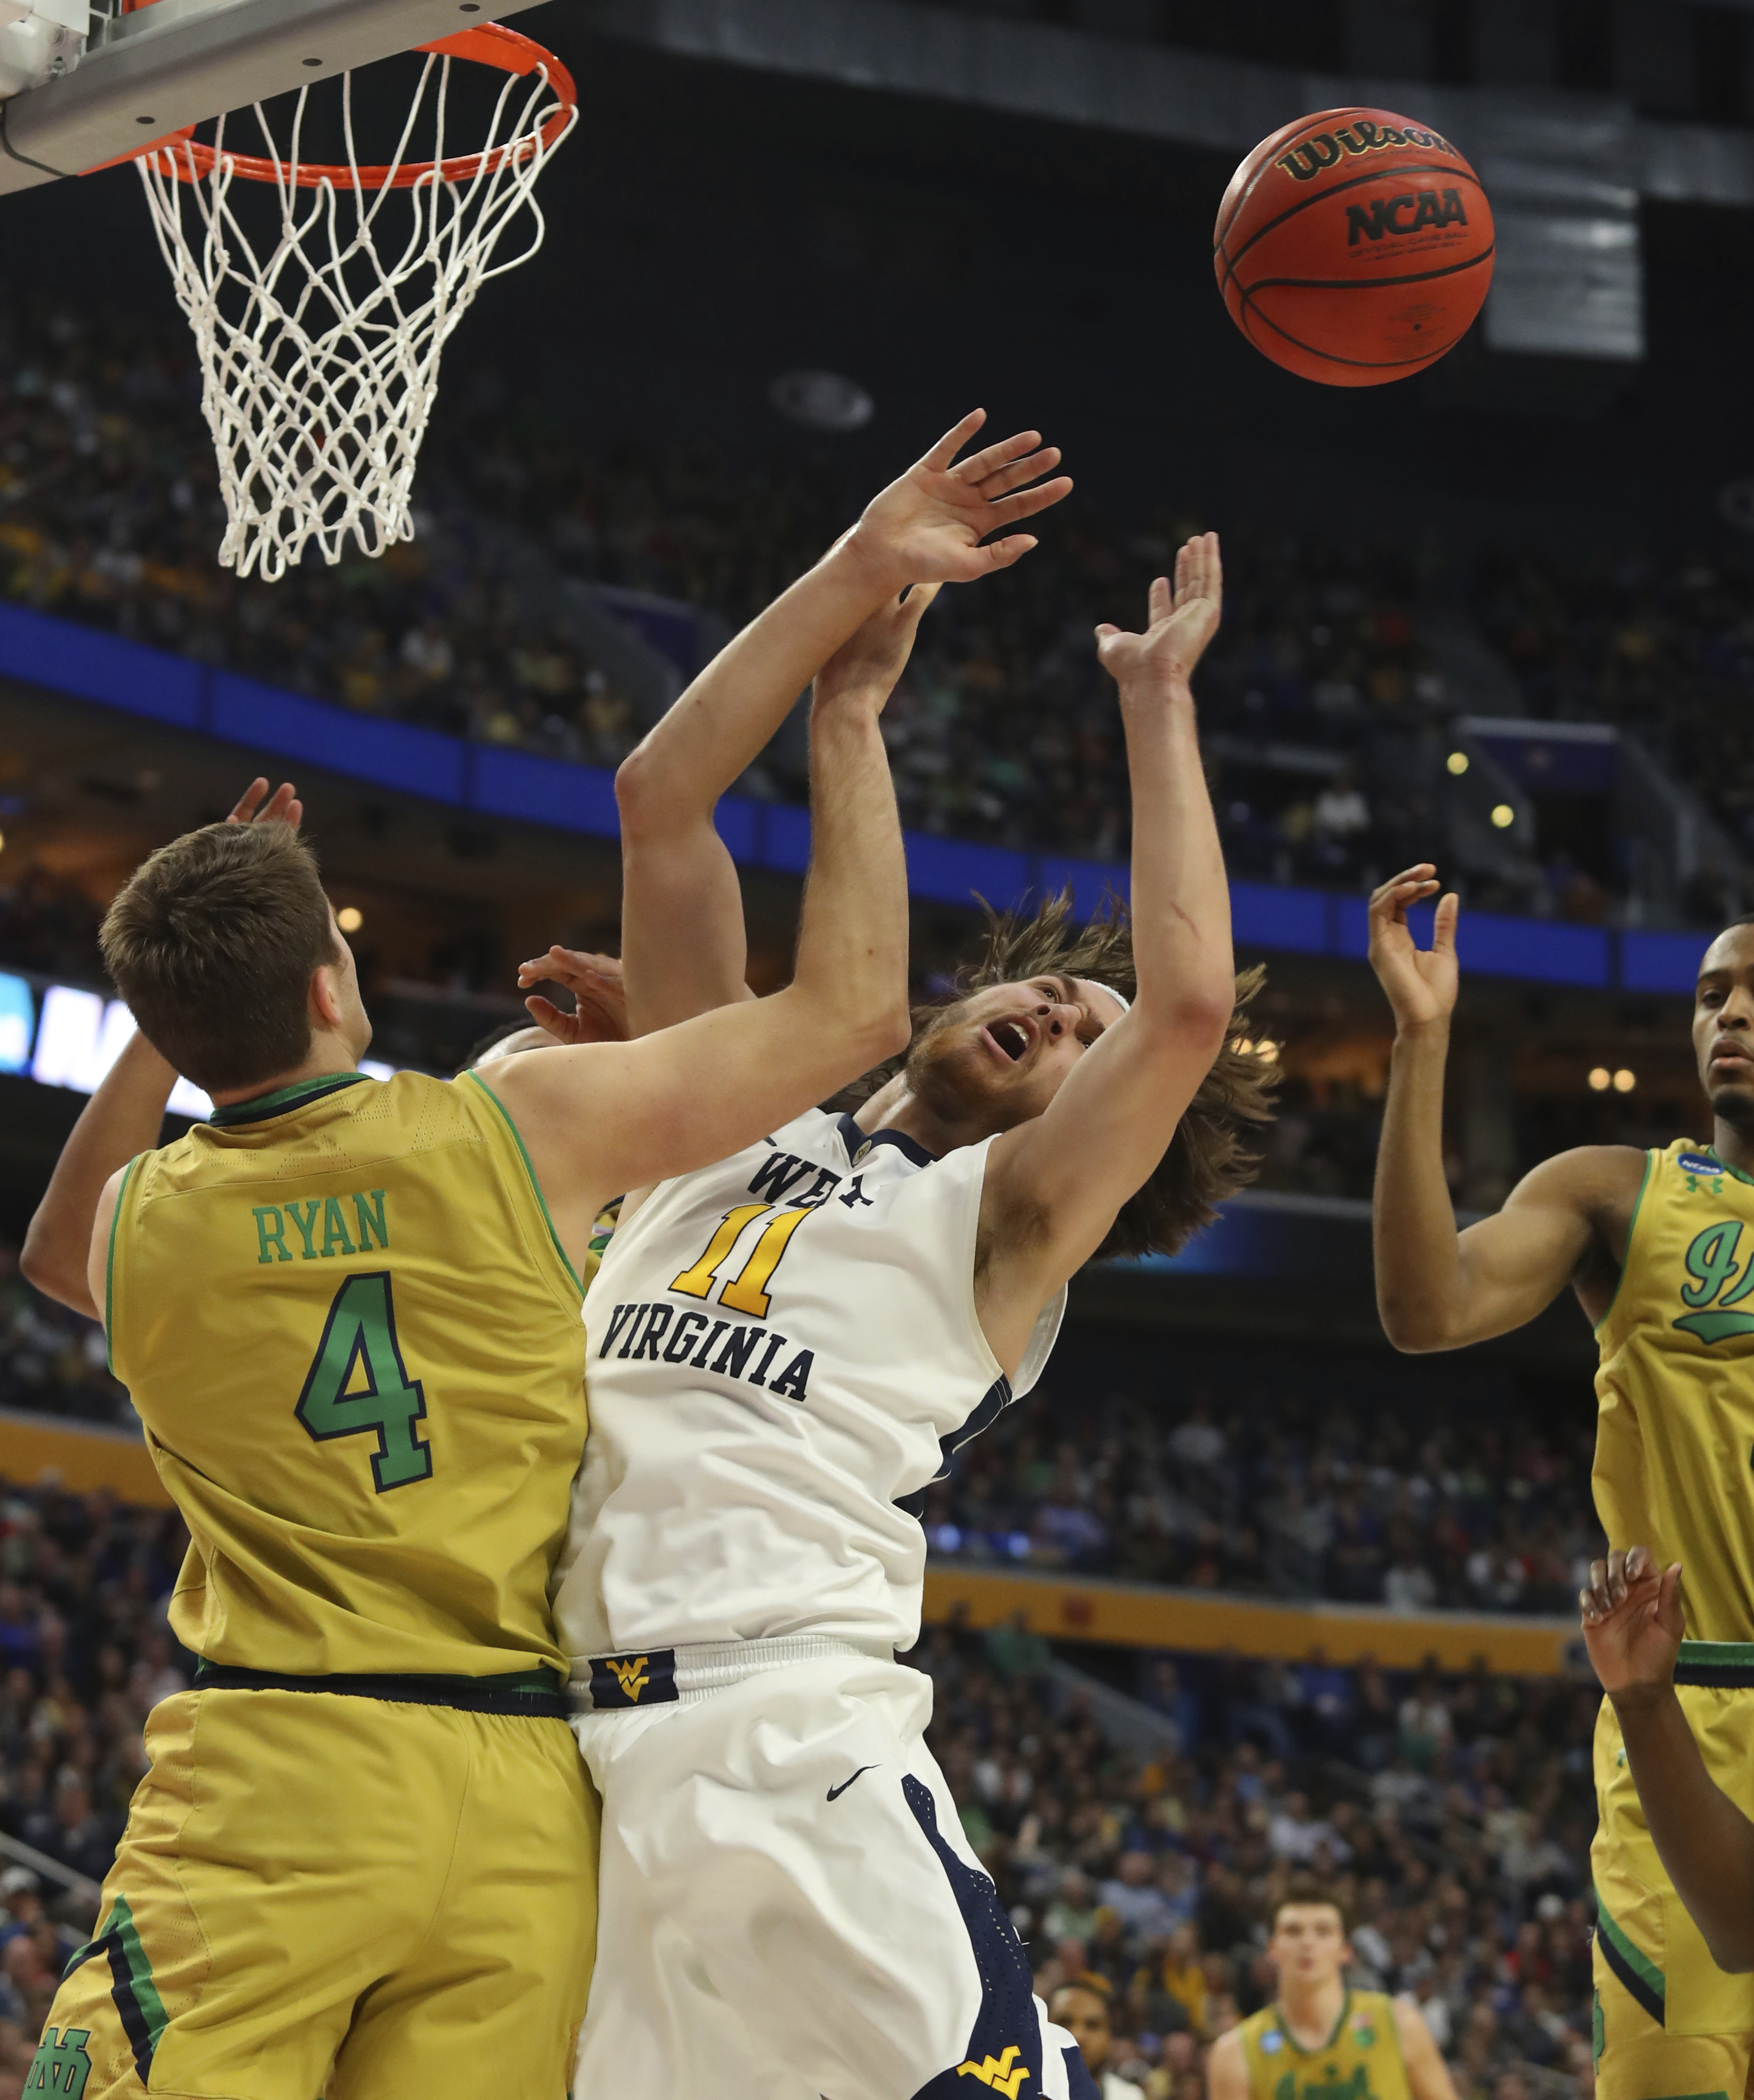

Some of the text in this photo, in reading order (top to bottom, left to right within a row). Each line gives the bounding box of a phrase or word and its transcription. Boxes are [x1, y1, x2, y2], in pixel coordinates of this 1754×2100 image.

[1274, 121, 1462, 182] Wilson
[1346, 188, 1467, 246] NCAA
[747, 1152, 874, 1209] WET
[252, 1189, 388, 1263] RYAN
[668, 1204, 814, 1320] 11
[294, 1271, 433, 1494] 4
[599, 1303, 815, 1402] VIRGINIA
